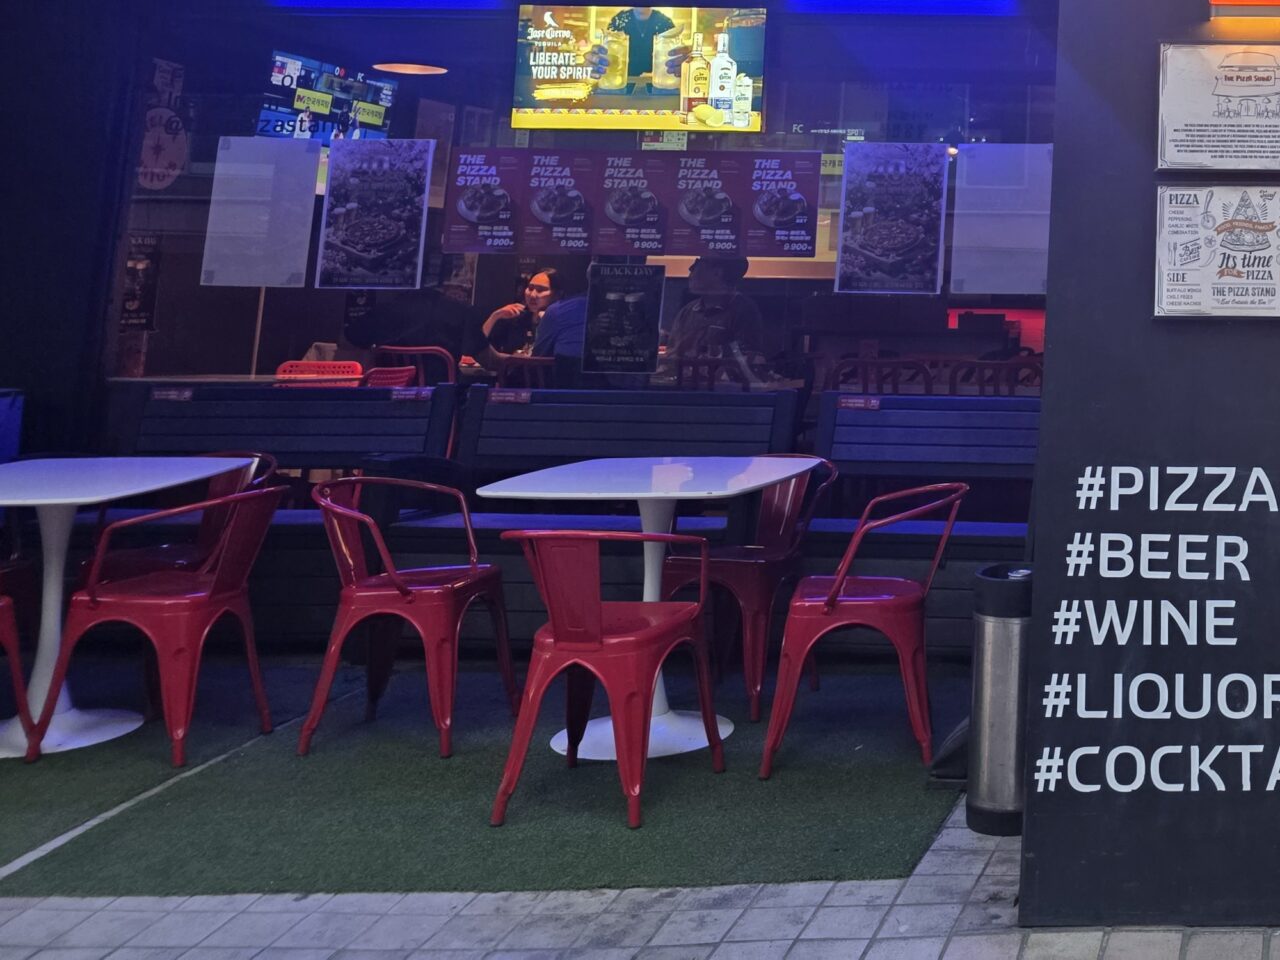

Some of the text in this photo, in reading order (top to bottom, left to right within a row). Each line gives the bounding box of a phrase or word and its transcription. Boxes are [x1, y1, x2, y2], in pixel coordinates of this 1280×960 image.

[530, 52, 576, 66] LIBERATE
[532, 66, 593, 80] YOUR SPIRIT
[459, 154, 486, 164] THE
[532, 156, 559, 165] THE
[606, 157, 632, 167] THE
[679, 158, 706, 167] THE
[754, 159, 780, 168] THE
[456, 165, 496, 175] PIZZA
[530, 167, 571, 176] PIZZA
[604, 168, 644, 178] PIZZA
[678, 169, 718, 179] PIZZA
[752, 170, 792, 180] PIZZA
[456, 176, 500, 186] STAND
[529, 178, 575, 188] STAND
[603, 179, 648, 189] STAND
[677, 180, 722, 189] STAND
[752, 181, 796, 191] STAND
[1169, 194, 1200, 205] PIZZA
[1240, 252, 1274, 268] time
[1166, 273, 1188, 282] SIDE
[1246, 270, 1274, 281] PIZZA
[1211, 286, 1276, 297] THE PIZZA STAND
[1076, 466, 1279, 512] #PIZZA
[1066, 532, 1250, 581] #BEER
[1052, 599, 1238, 646] #WINE
